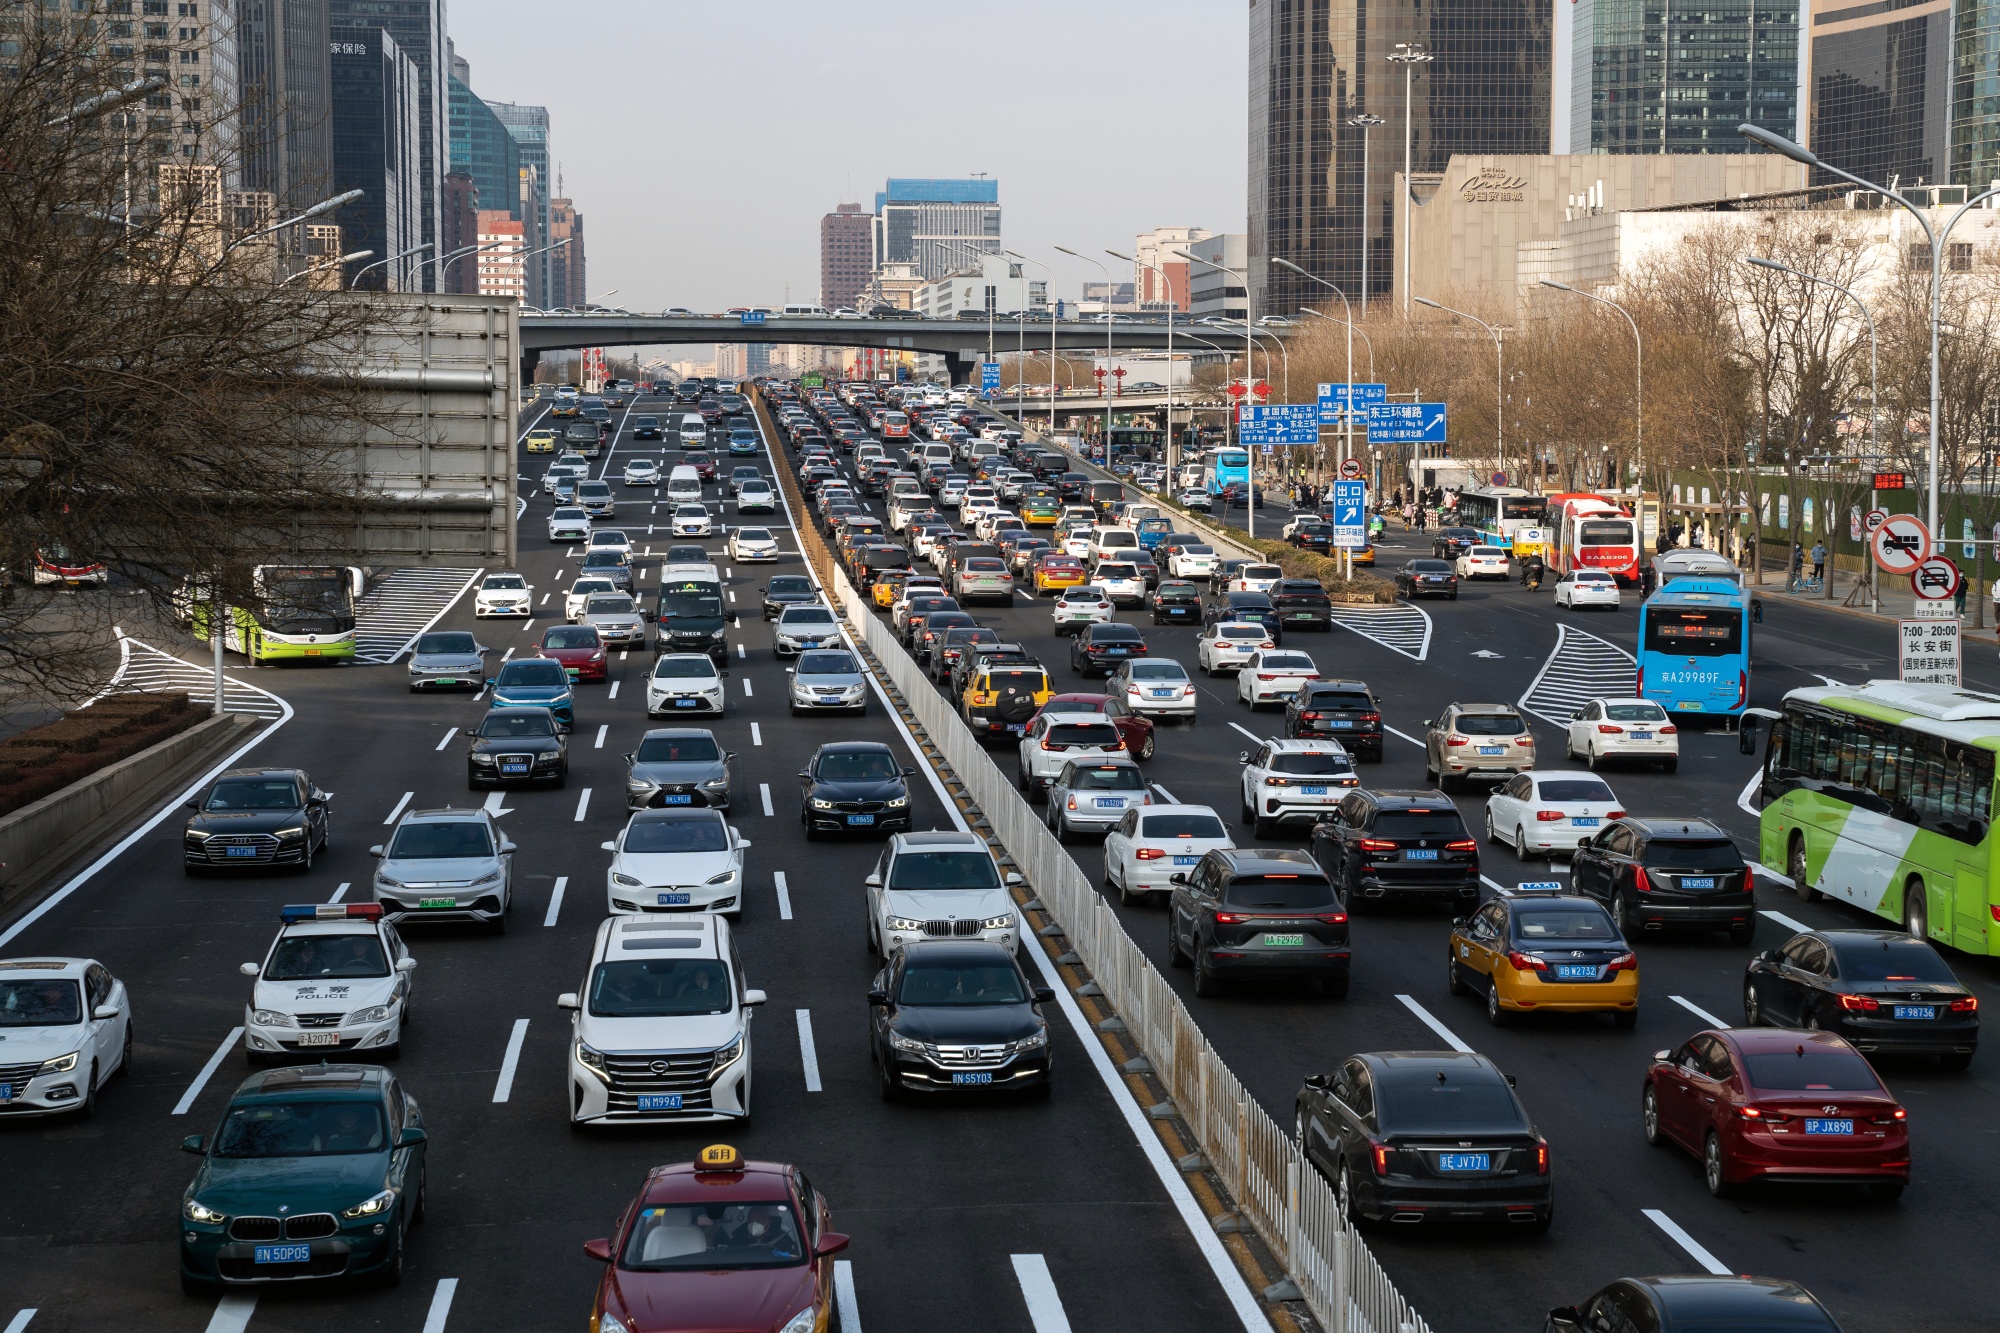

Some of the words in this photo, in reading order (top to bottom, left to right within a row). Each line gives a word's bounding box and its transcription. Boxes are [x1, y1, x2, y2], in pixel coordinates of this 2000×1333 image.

[330, 43, 366, 54] 家保险
[1476, 192, 1524, 202] 国贸商城
[1262, 407, 1289, 416] 建国路
[1370, 406, 1422, 418] 东三环辅路
[1241, 421, 1268, 429] 东南三环
[1290, 420, 1316, 428] 东北三环
[1337, 485, 1361, 496] 出口
[1335, 528, 1364, 536] 东三环辅路
[1908, 640, 1952, 652] 长安街
[1902, 658, 1958, 670] (国贸桥至新兴桥)
[1662, 672, 1720, 683] 京A29989F
[297, 986, 350, 994] 警察
[1807, 1121, 1852, 1132] 京P·JX890
[708, 1149, 730, 1160] 新月
[256, 1247, 309, 1261] 京N·5DP05
